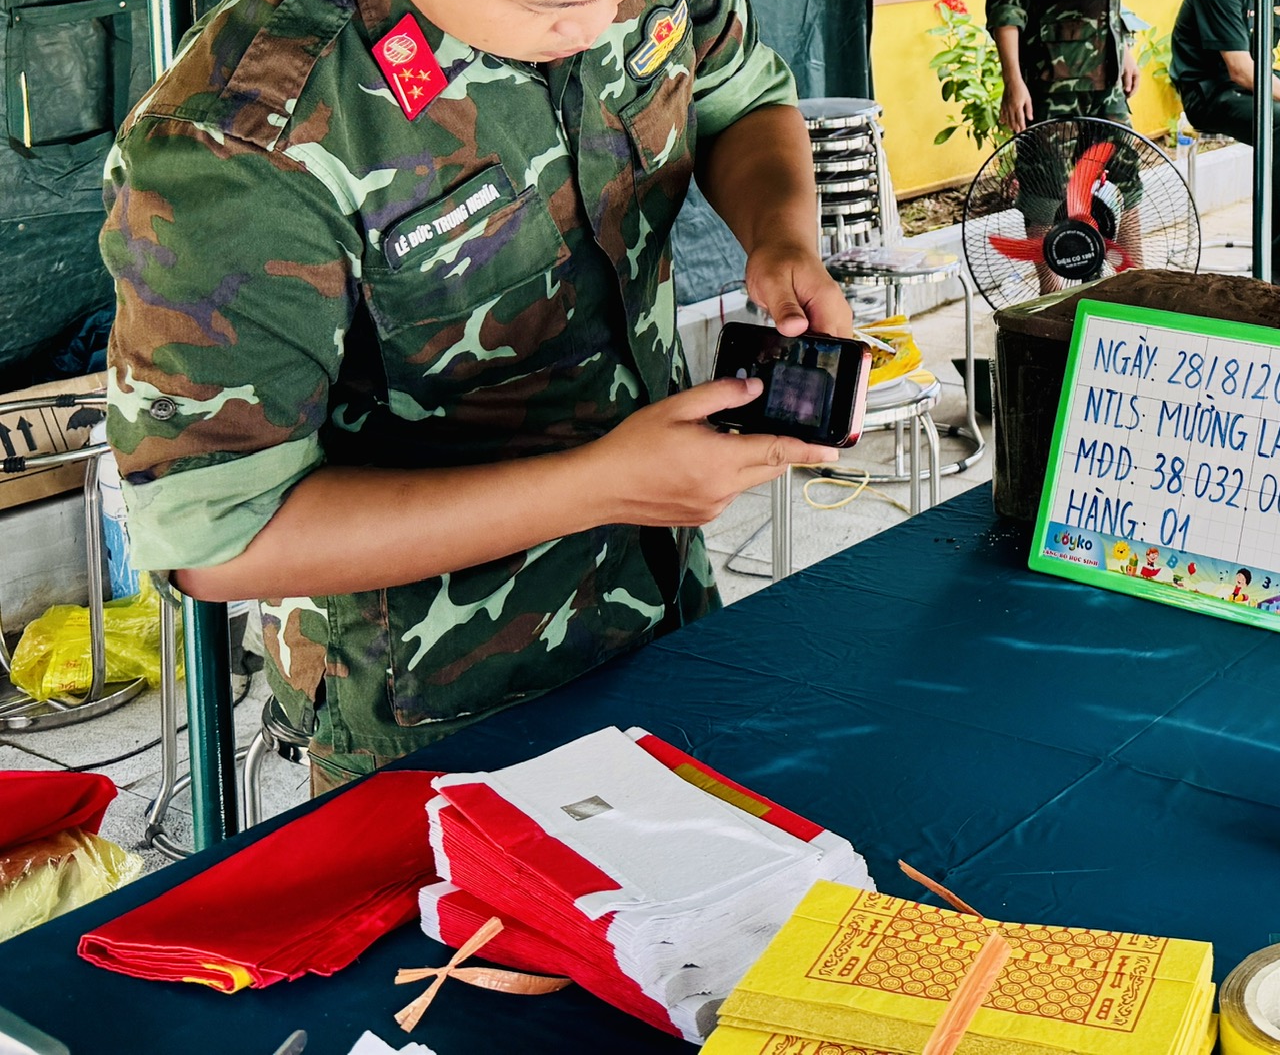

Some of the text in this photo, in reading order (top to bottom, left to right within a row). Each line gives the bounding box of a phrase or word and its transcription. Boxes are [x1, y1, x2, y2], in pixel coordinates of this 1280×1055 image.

[394, 234, 411, 257] LÊ
[408, 224, 434, 248] ĐỨC
[432, 204, 469, 235] TRUNG
[1093, 335, 1158, 382] NGÀY:
[1083, 386, 1146, 433] NTLS:
[1157, 393, 1249, 452] MƯỜNG
[1065, 487, 1191, 554] HÀNG: 01
